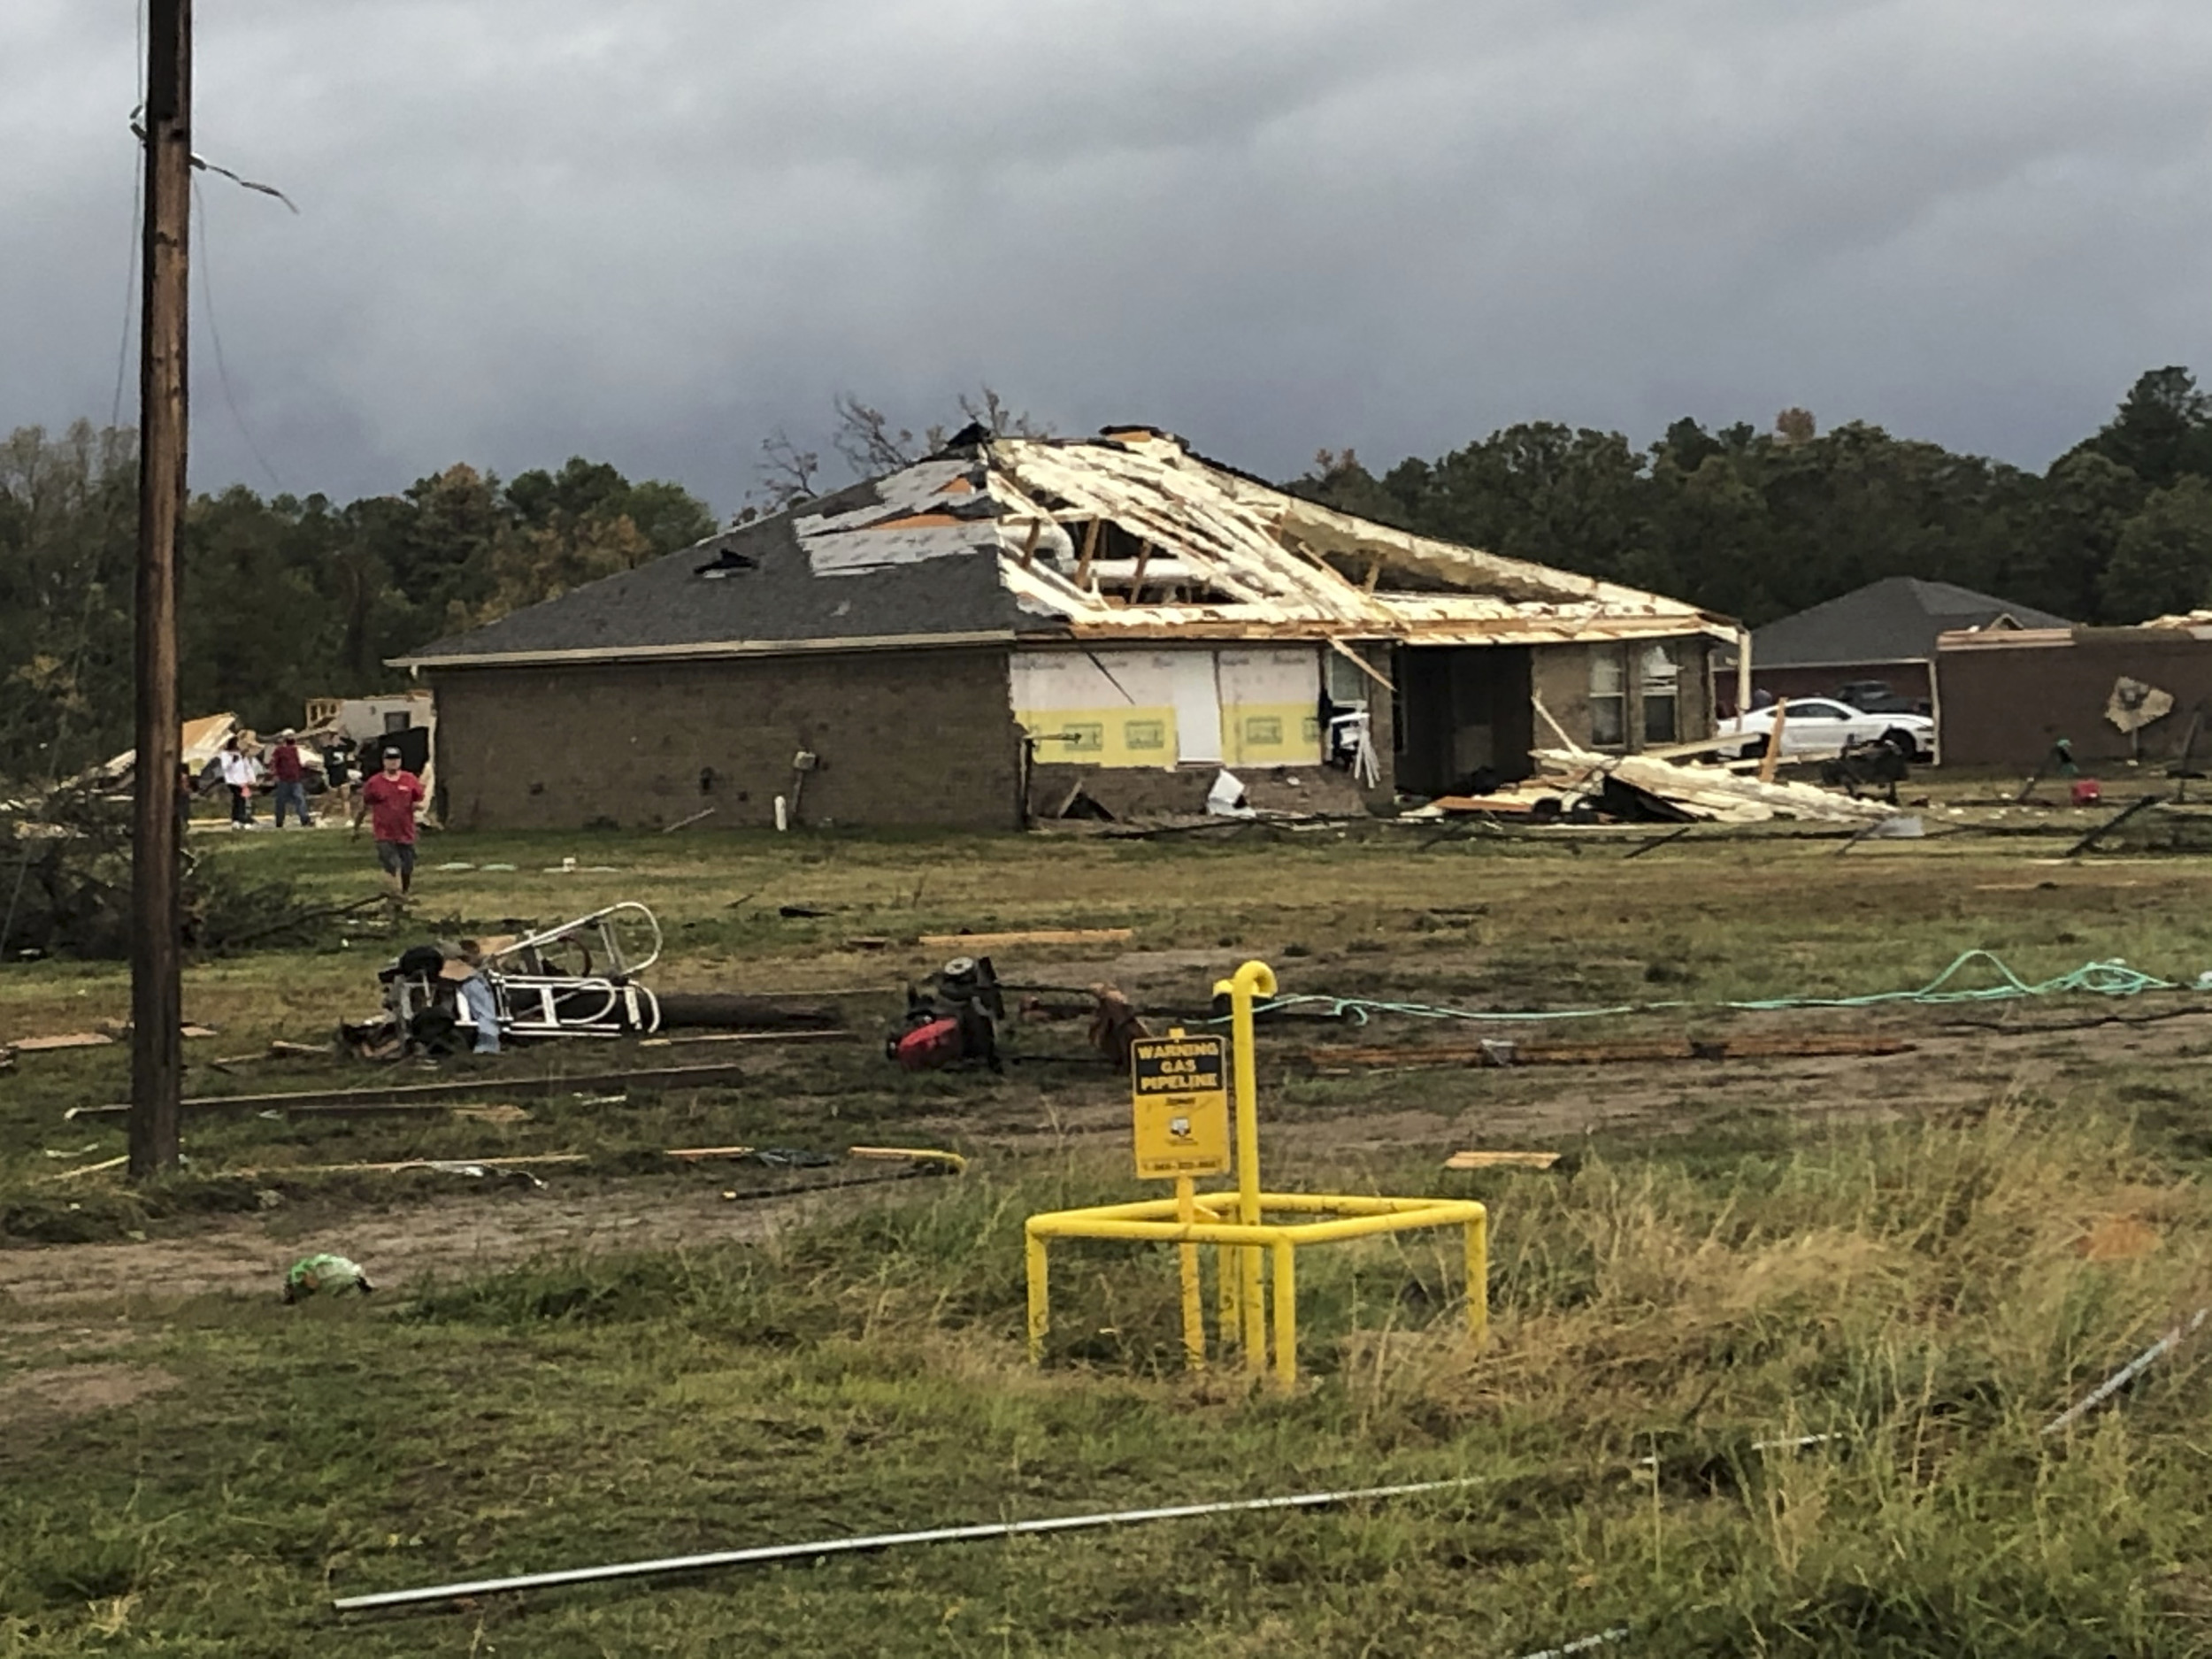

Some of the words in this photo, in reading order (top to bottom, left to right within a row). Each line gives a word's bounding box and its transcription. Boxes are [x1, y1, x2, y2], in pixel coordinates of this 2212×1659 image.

[1138, 1042, 1218, 1059] WARNING
[1160, 1059, 1196, 1073] GAS
[1141, 1073, 1217, 1090] PIPELINE
